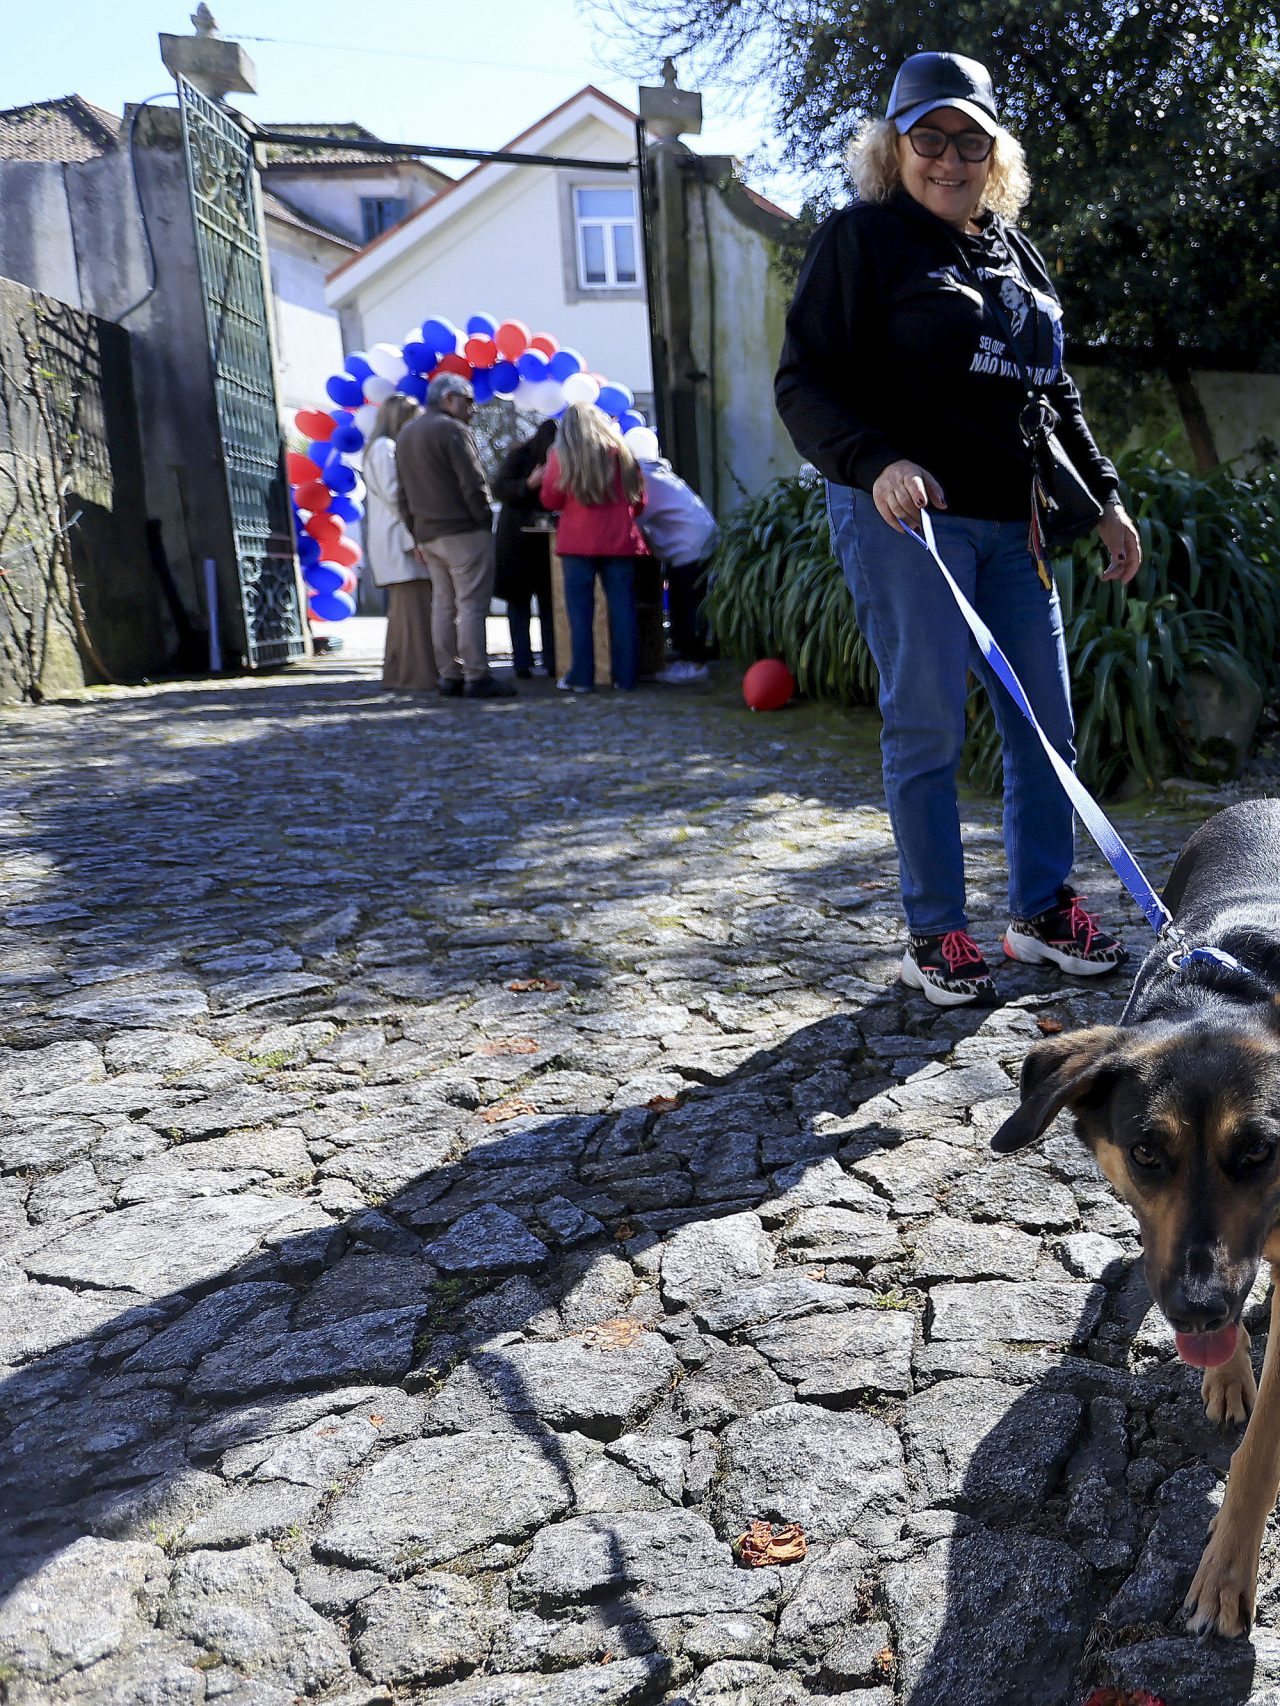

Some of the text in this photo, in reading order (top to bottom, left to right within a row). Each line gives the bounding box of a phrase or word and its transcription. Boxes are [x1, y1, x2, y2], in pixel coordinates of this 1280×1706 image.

[979, 335, 1006, 355] SEI QUE
[969, 351, 998, 374] NÃO
